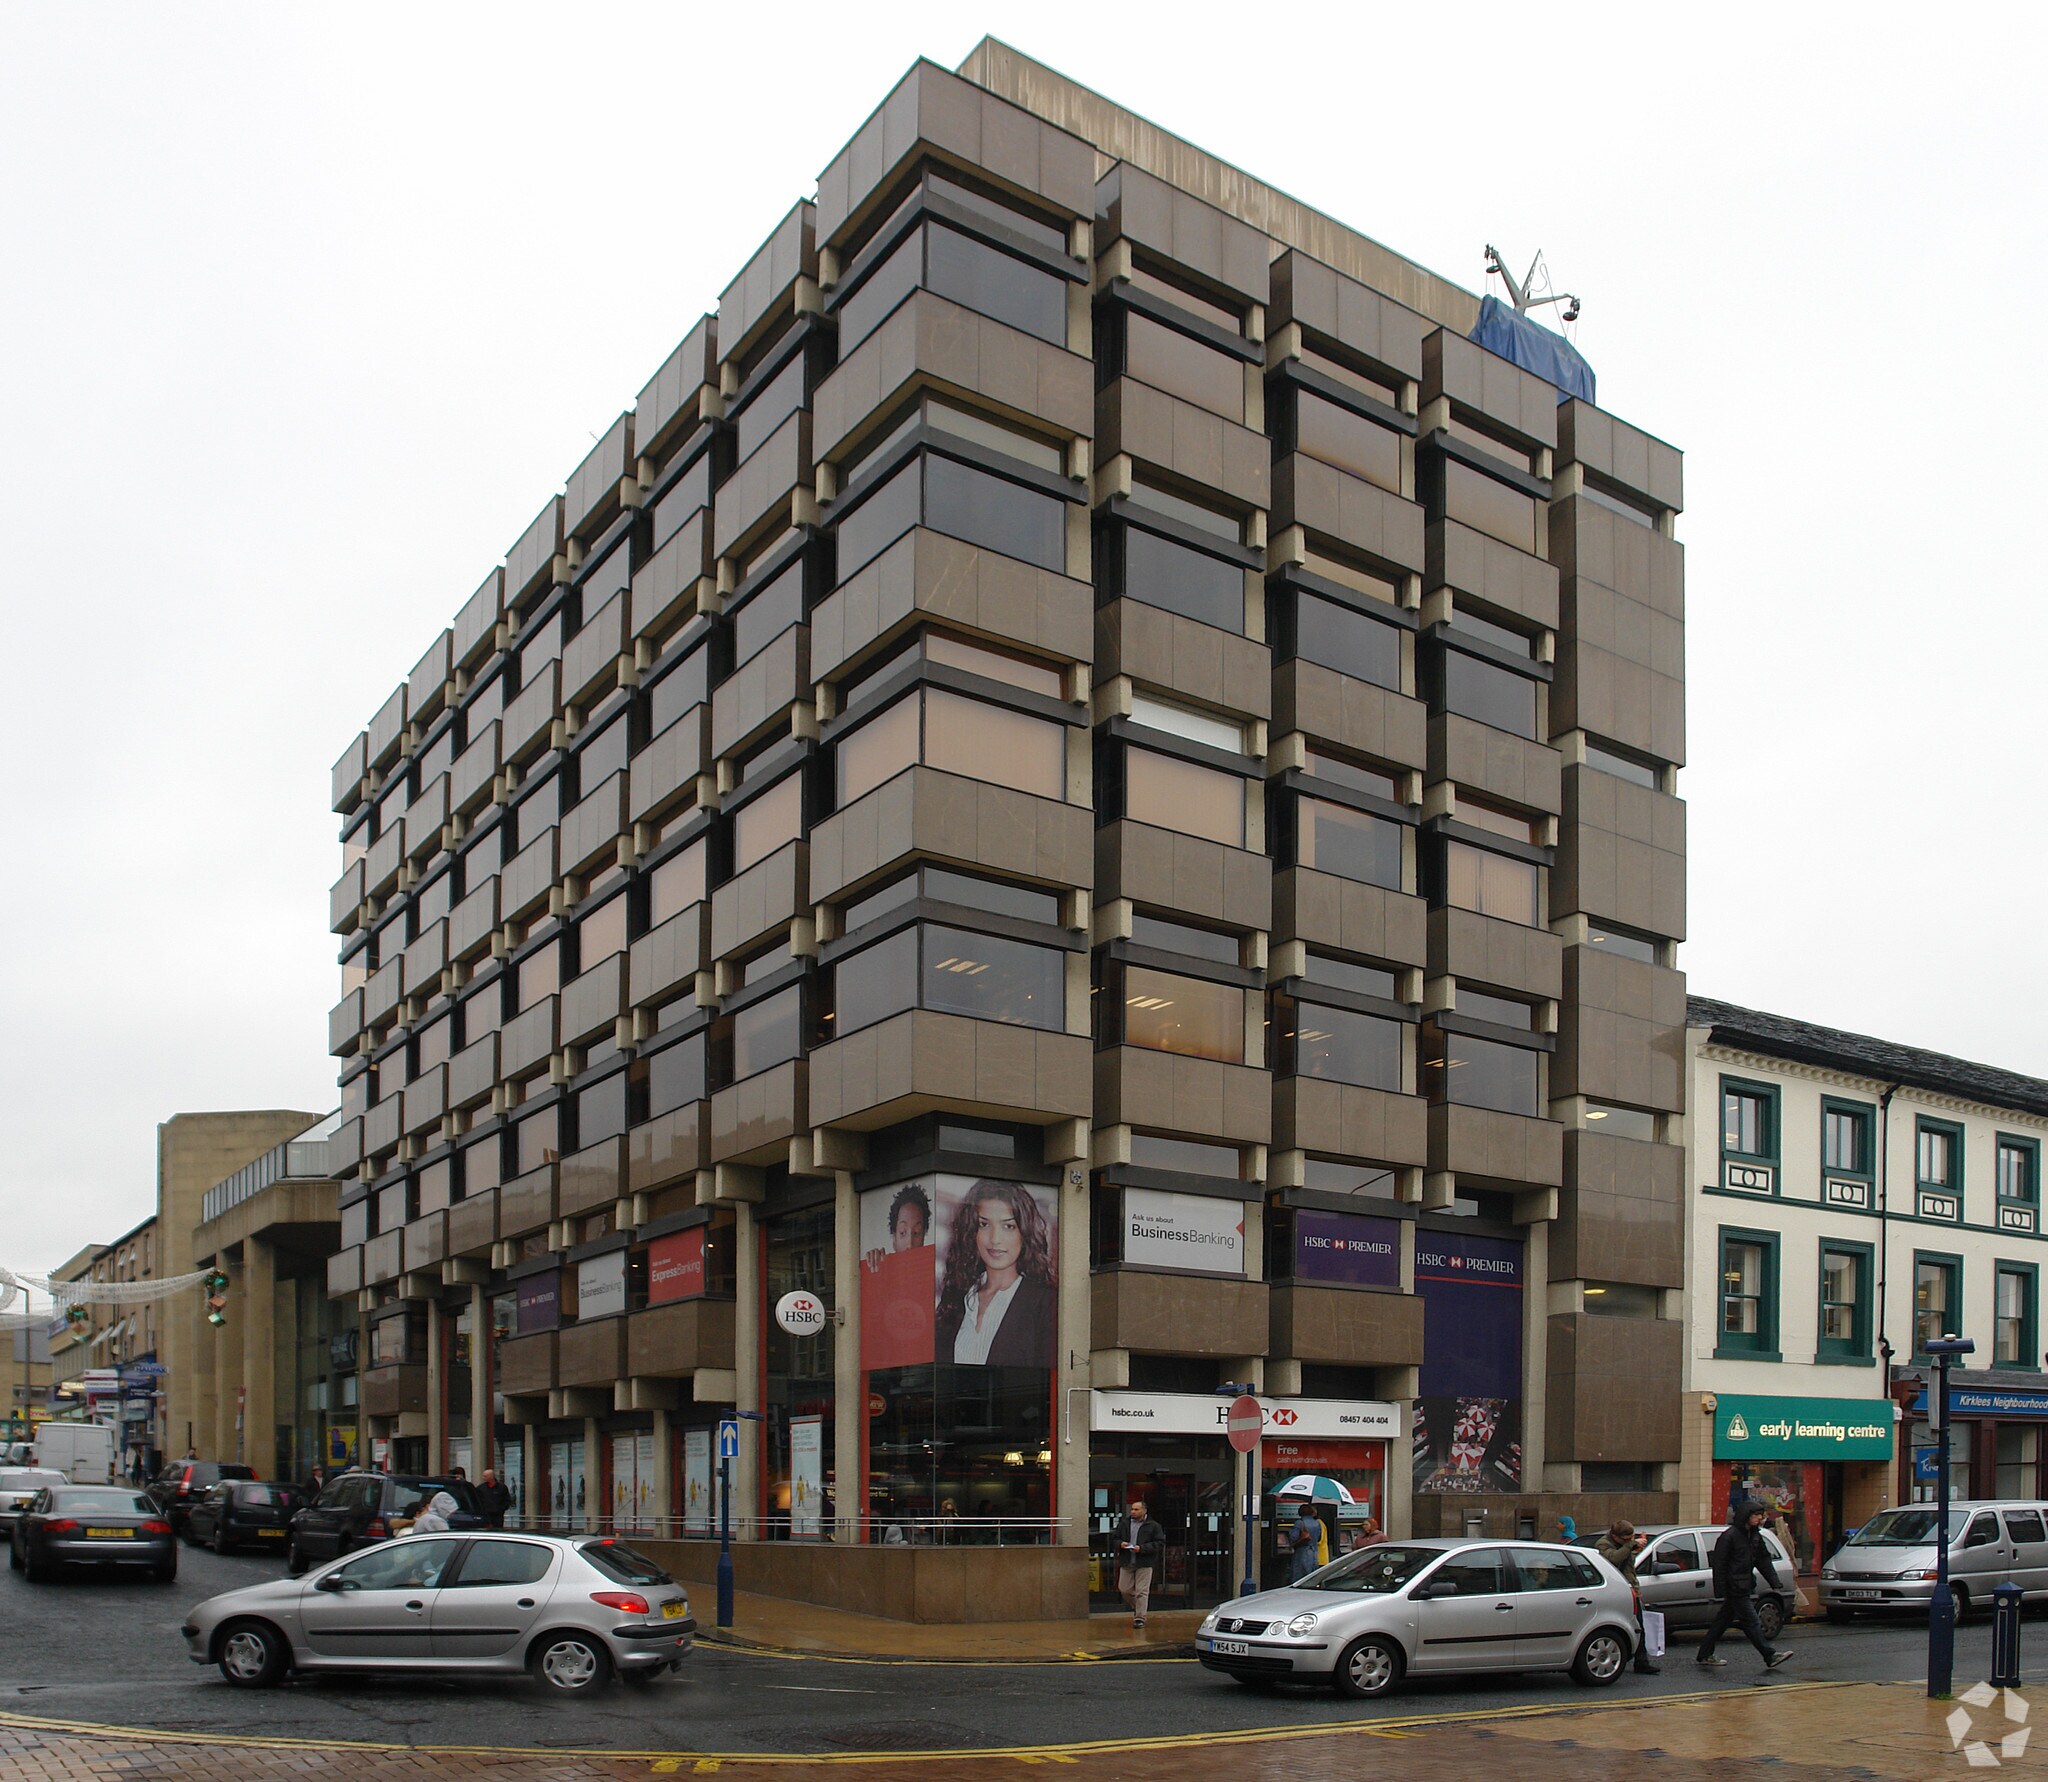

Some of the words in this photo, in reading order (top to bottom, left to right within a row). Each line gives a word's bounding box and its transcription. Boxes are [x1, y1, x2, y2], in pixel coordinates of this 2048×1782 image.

[1132, 1213, 1144, 1221] Ask
[1155, 1215, 1174, 1224] about
[1131, 1223, 1235, 1249] BusinessBanking
[1304, 1236, 1331, 1249] HSBC
[1348, 1240, 1392, 1255] PREMIER
[1416, 1252, 1447, 1267] HSBC
[1466, 1257, 1515, 1275] PREMIER
[784, 1311, 822, 1324] HSBC
[1959, 1395, 1991, 1407] Kirklees
[1111, 1408, 1155, 1417] hsbc.co.uk
[1339, 1415, 1361, 1424] 08457
[1759, 1420, 1792, 1441] early
[1795, 1420, 1845, 1442] learning
[1847, 1424, 1886, 1438] centre
[1277, 1444, 1298, 1455] Free
[1277, 1456, 1291, 1464] cash
[1292, 1456, 1328, 1464] withdrawals
[1231, 1643, 1247, 1655] SJX
